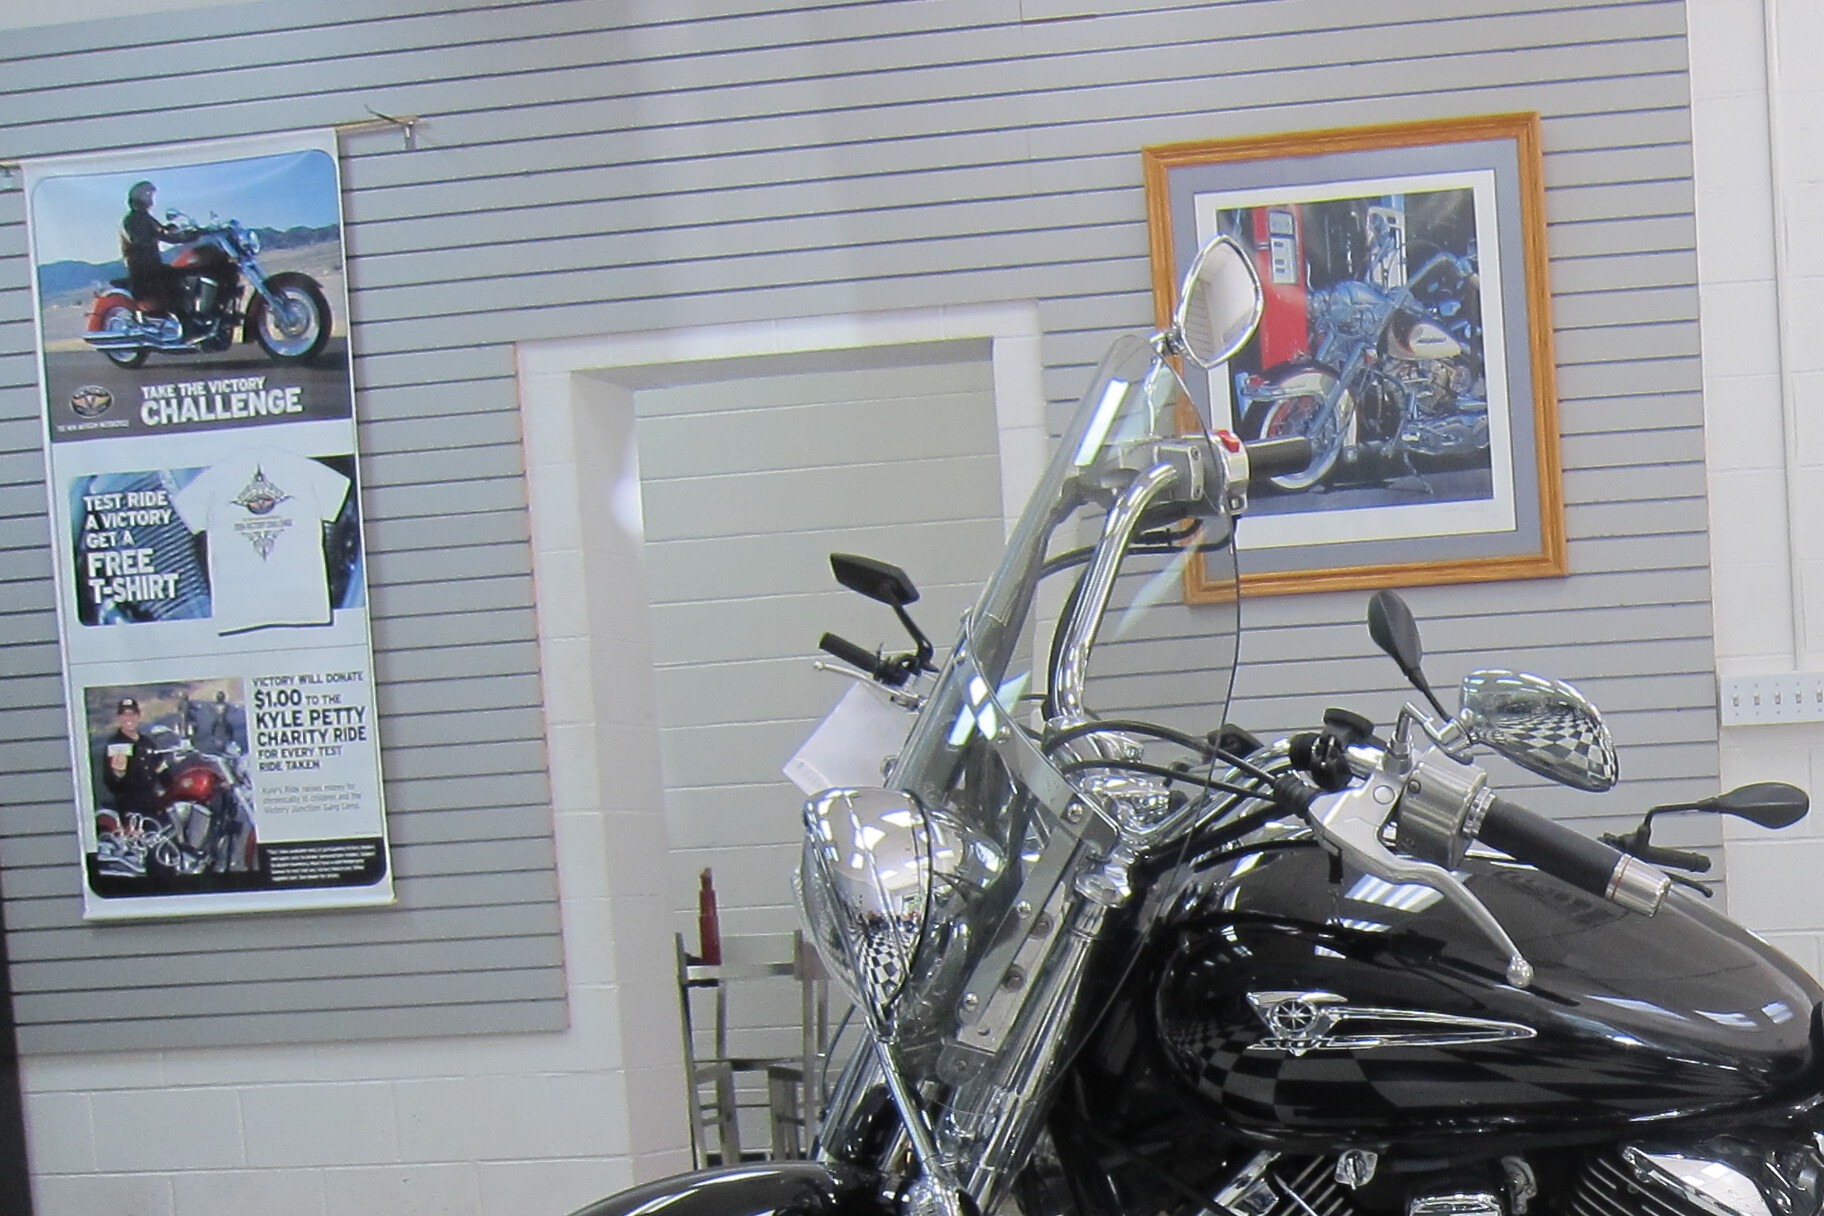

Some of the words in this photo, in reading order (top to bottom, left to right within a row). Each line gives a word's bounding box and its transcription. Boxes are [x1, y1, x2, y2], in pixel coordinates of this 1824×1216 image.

[141, 384, 176, 399] TAKE
[180, 382, 206, 396] THE
[208, 376, 266, 394] VICTORY
[140, 387, 304, 426] CHALLENGE
[83, 493, 122, 511] TEST
[127, 491, 168, 507] RIDE
[85, 514, 99, 530] A
[100, 508, 172, 528] VICTORY
[86, 531, 117, 548] GET
[121, 530, 135, 545] A
[87, 548, 155, 577] FREE
[88, 573, 179, 604] T-SHIRT
[253, 676, 295, 687] VICTORY
[298, 674, 322, 685] WILL
[325, 671, 364, 683] DONATE
[255, 689, 302, 709] $1.00
[305, 695, 319, 705] TO
[322, 694, 342, 704] THE
[256, 710, 303, 729] KYLE
[309, 706, 366, 726] PETTY
[257, 729, 329, 747] CHARITY
[333, 726, 367, 742] RIDE
[258, 749, 278, 760] FOR
[281, 747, 314, 758] EVERY
[318, 746, 343, 756] TEST
[259, 761, 283, 772] RIDE
[285, 760, 320, 771] TAKEN
